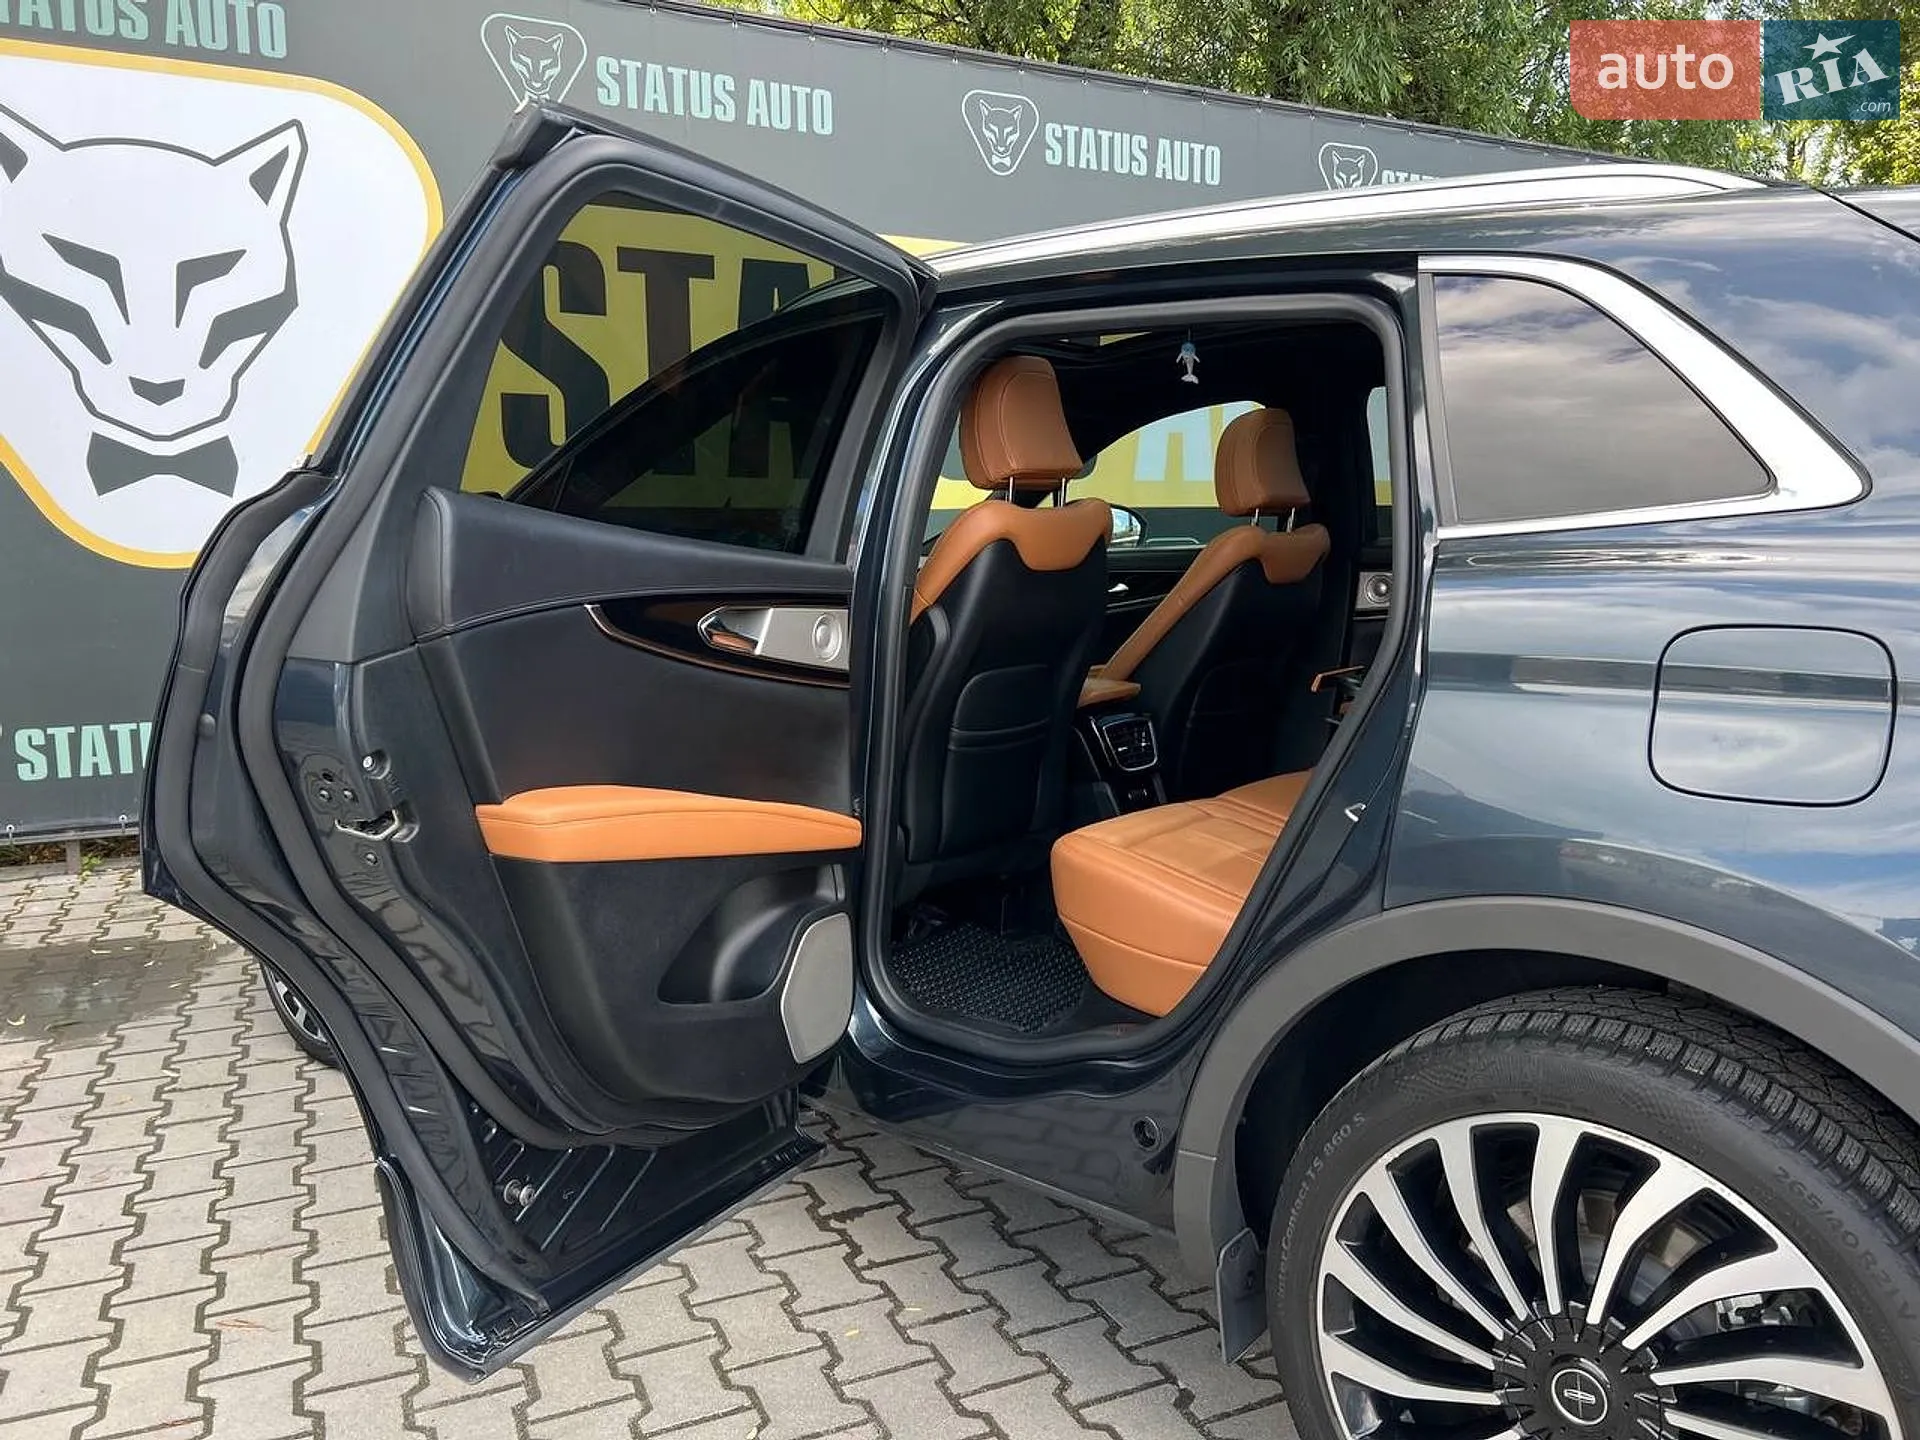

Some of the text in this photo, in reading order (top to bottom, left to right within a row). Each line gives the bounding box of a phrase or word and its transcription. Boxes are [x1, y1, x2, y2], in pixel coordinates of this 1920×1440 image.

[165, 0, 287, 59] AUTO
[596, 55, 833, 136] STATUS AUTO
[1045, 122, 1221, 186] STATUS AUTO
[1323, 1124, 1352, 1156] 860
[1353, 1112, 1366, 1128] S
